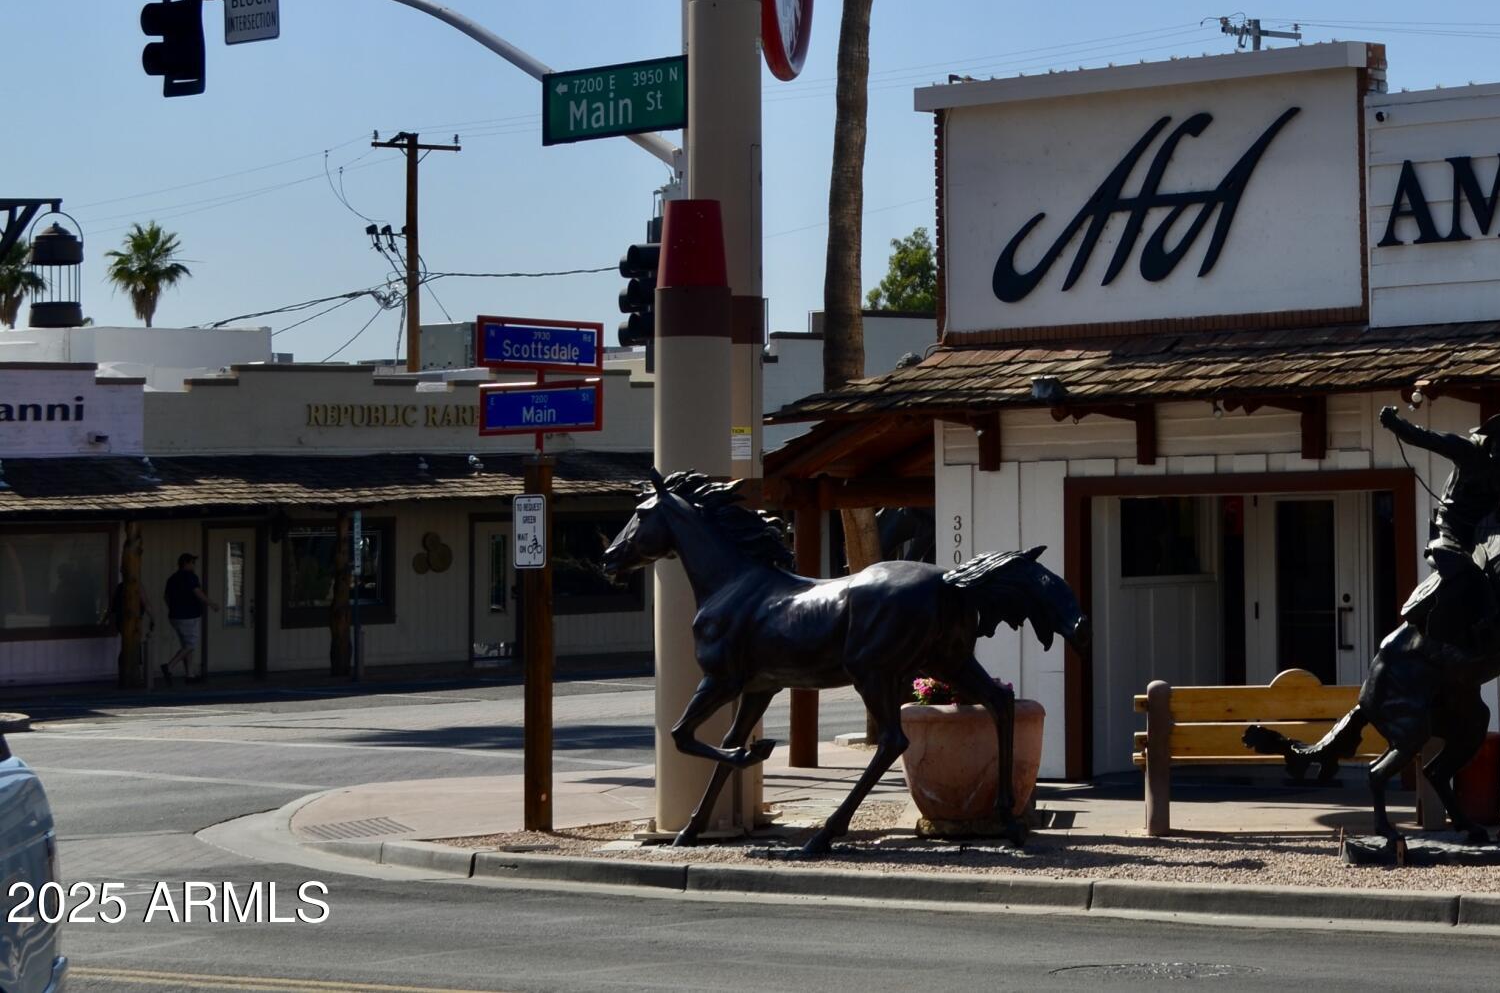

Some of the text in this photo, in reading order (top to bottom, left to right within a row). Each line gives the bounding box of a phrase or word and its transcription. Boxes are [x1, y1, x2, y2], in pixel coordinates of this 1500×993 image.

[227, 11, 276, 32] INTERSECTION
[573, 67, 678, 94] 7200 E 3950 N
[569, 90, 662, 131] Main St
[502, 339, 580, 360] Scottsdale
[0, 396, 84, 421] anni
[307, 404, 417, 428] REPUBLIC
[522, 405, 556, 423] Main
[517, 533, 528, 541] WAIT
